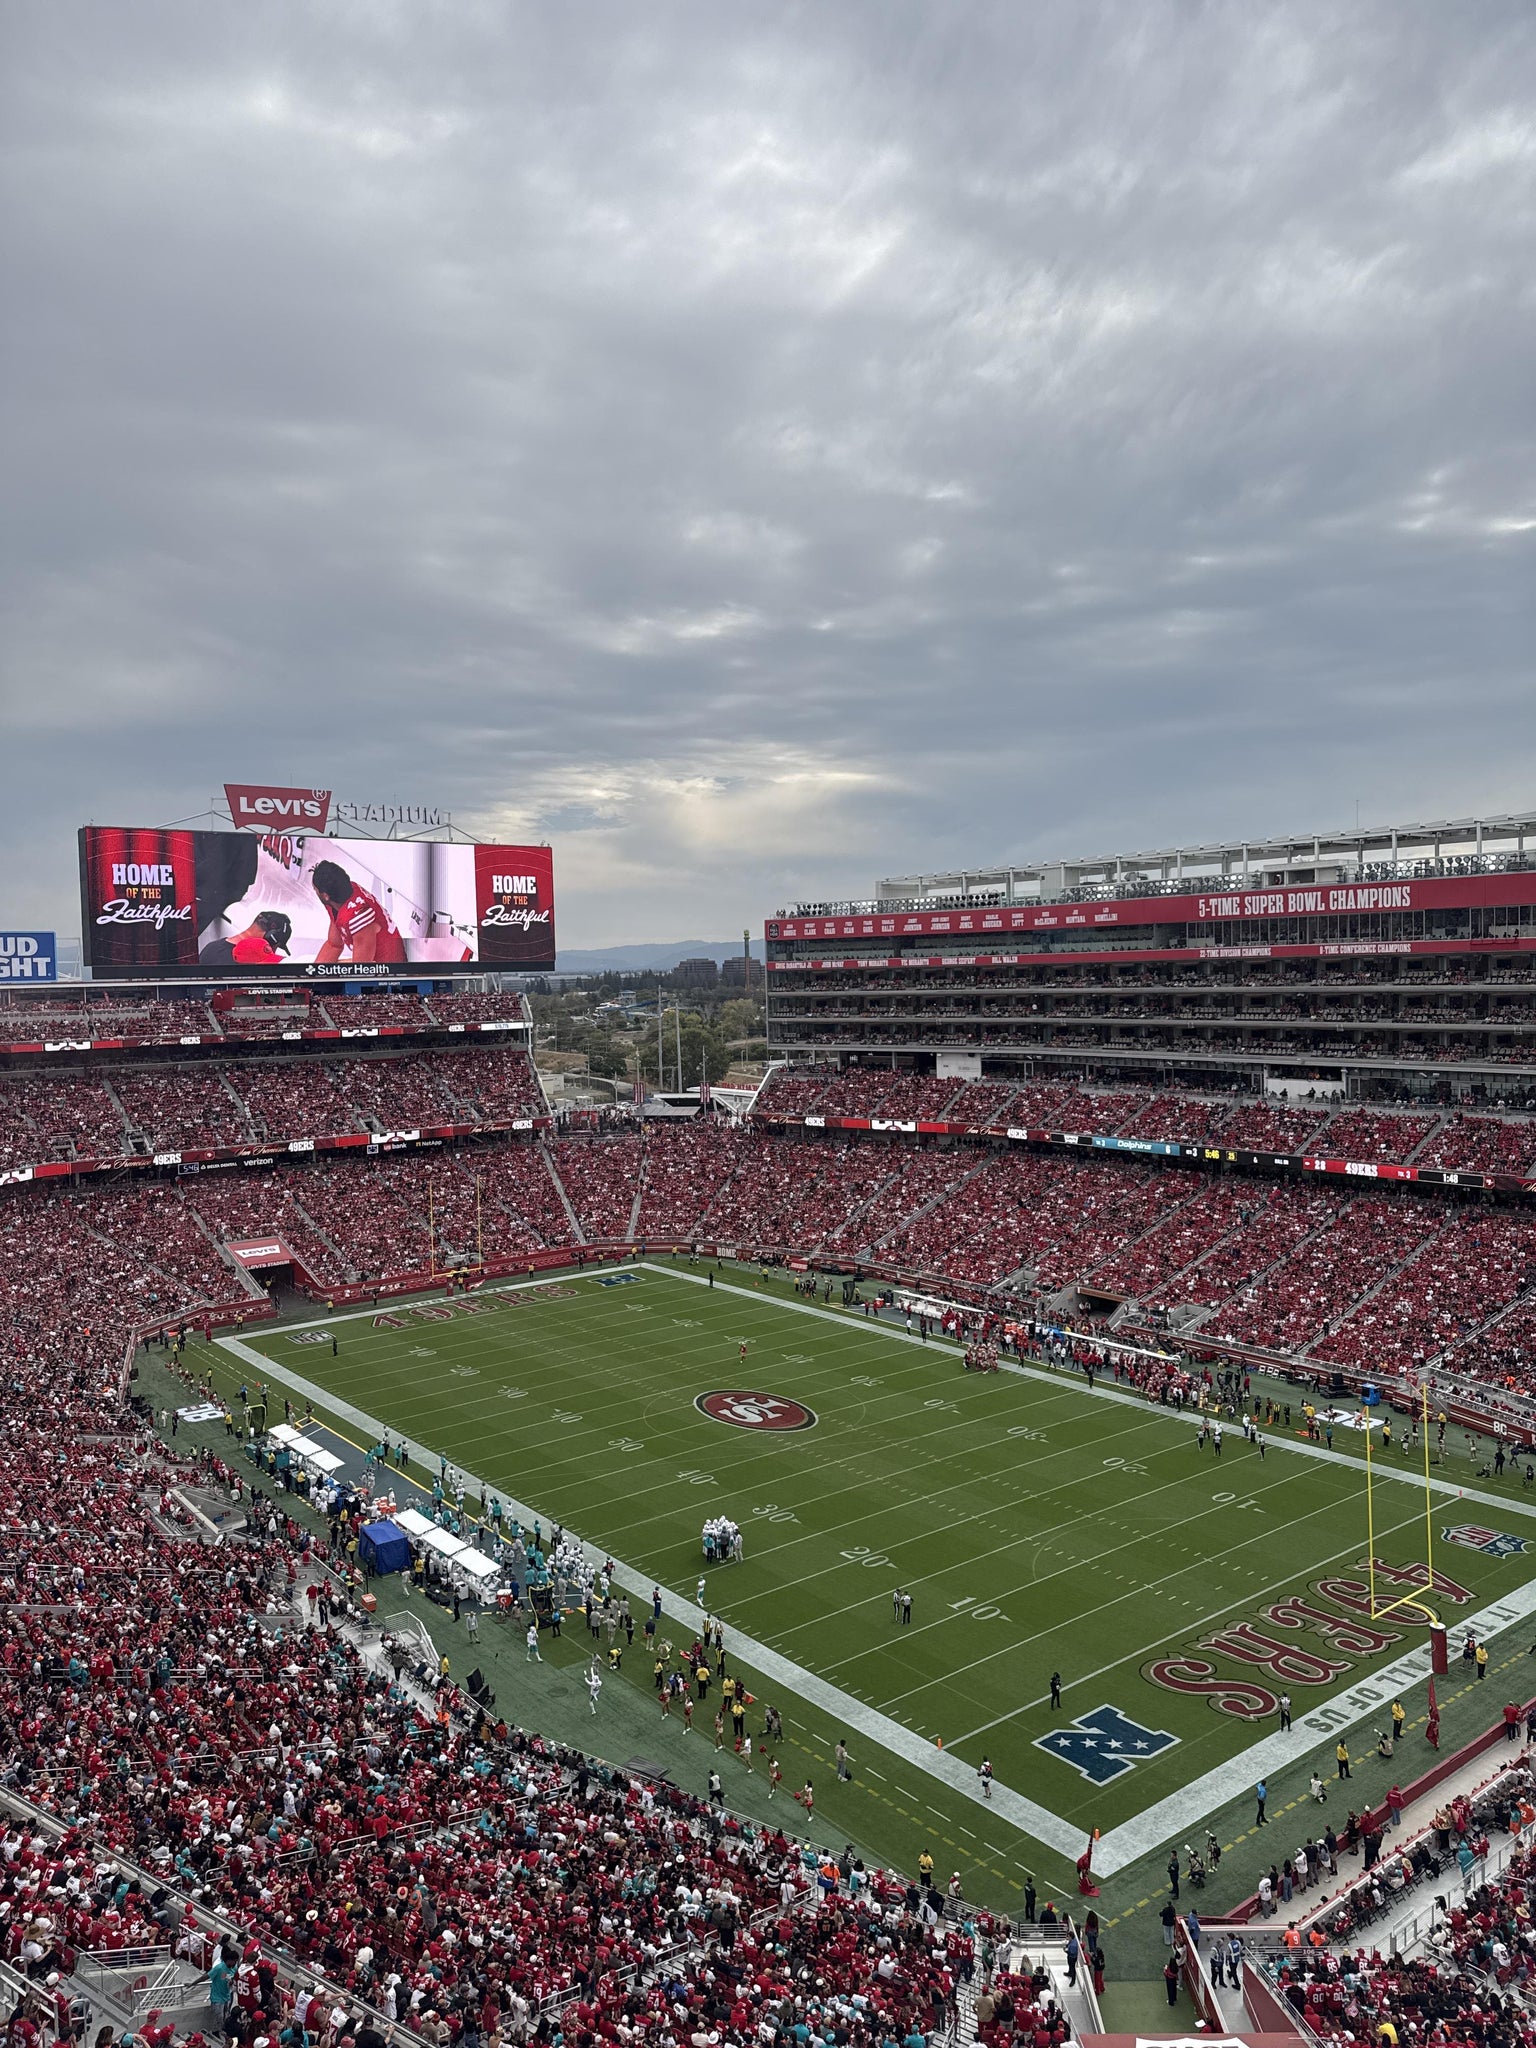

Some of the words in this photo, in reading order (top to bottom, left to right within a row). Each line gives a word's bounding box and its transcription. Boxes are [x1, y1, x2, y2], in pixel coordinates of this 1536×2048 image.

[337, 801, 445, 827] STADIUM
[112, 863, 174, 886] HOME
[492, 874, 537, 894] HOME
[126, 887, 139, 899] OF
[141, 887, 162, 899] THE
[502, 895, 511, 905] OF
[514, 895, 528, 905] THE
[1198, 897, 1240, 917] 5-TIME
[1244, 894, 1284, 914] SUPER
[1287, 891, 1325, 912] BOWL
[1329, 886, 1411, 910] CHAMPIONS
[96, 898, 192, 930] Faithful
[481, 904, 550, 931] Faithful
[0, 936, 39, 957] UD
[1241, 947, 1272, 957] CHAMPIONS
[1339, 944, 1377, 954] CONFERENCE
[1377, 943, 1411, 953] CHAMPIONS
[317, 964, 353, 975] Sutter
[354, 963, 390, 974] Health
[180, 1037, 201, 1045] 49ERS
[282, 1032, 302, 1040] 49ERS
[511, 1119, 533, 1130] 49ERS
[805, 1116, 826, 1127] 49ERS
[1006, 1128, 1028, 1140] 49ERS
[288, 1140, 314, 1152] 49ERS
[1117, 1139, 1152, 1151] Dolphins
[1165, 1145, 1171, 1154] 6
[1192, 1147, 1198, 1157] 3
[1204, 1149, 1220, 1160] 5:46
[153, 1153, 182, 1166] 49ERS
[243, 1157, 274, 1167] verizon
[1344, 1162, 1378, 1177] 49ERS
[1405, 1170, 1411, 1179] 3
[1443, 1173, 1459, 1184] 1:48
[716, 1246, 737, 1258] HOME
[267, 1260, 290, 1268] STADIUM
[372, 1285, 579, 1329] 49ERS
[850, 1375, 885, 1387] 50
[1007, 1426, 1047, 1440] 30
[608, 1437, 644, 1452] 50
[1102, 1457, 1148, 1473] 20
[676, 1469, 714, 1485] 40
[1211, 1492, 1261, 1509] 10
[752, 1504, 795, 1523] 30
[839, 1546, 889, 1568] 20
[947, 1596, 1001, 1621] 10
[1487, 1605, 1521, 1622] IT
[1148, 1556, 1479, 1722] 49ERS
[1374, 1658, 1429, 1687] ALL
[1345, 1686, 1385, 1711] OF
[1303, 1708, 1351, 1733] US
[1293, 1935, 1299, 1945] 9
[1326, 1961, 1338, 1974] 85
[237, 1980, 250, 1997] 85
[533, 1987, 543, 1999] 19
[1312, 1993, 1325, 2004] 80
